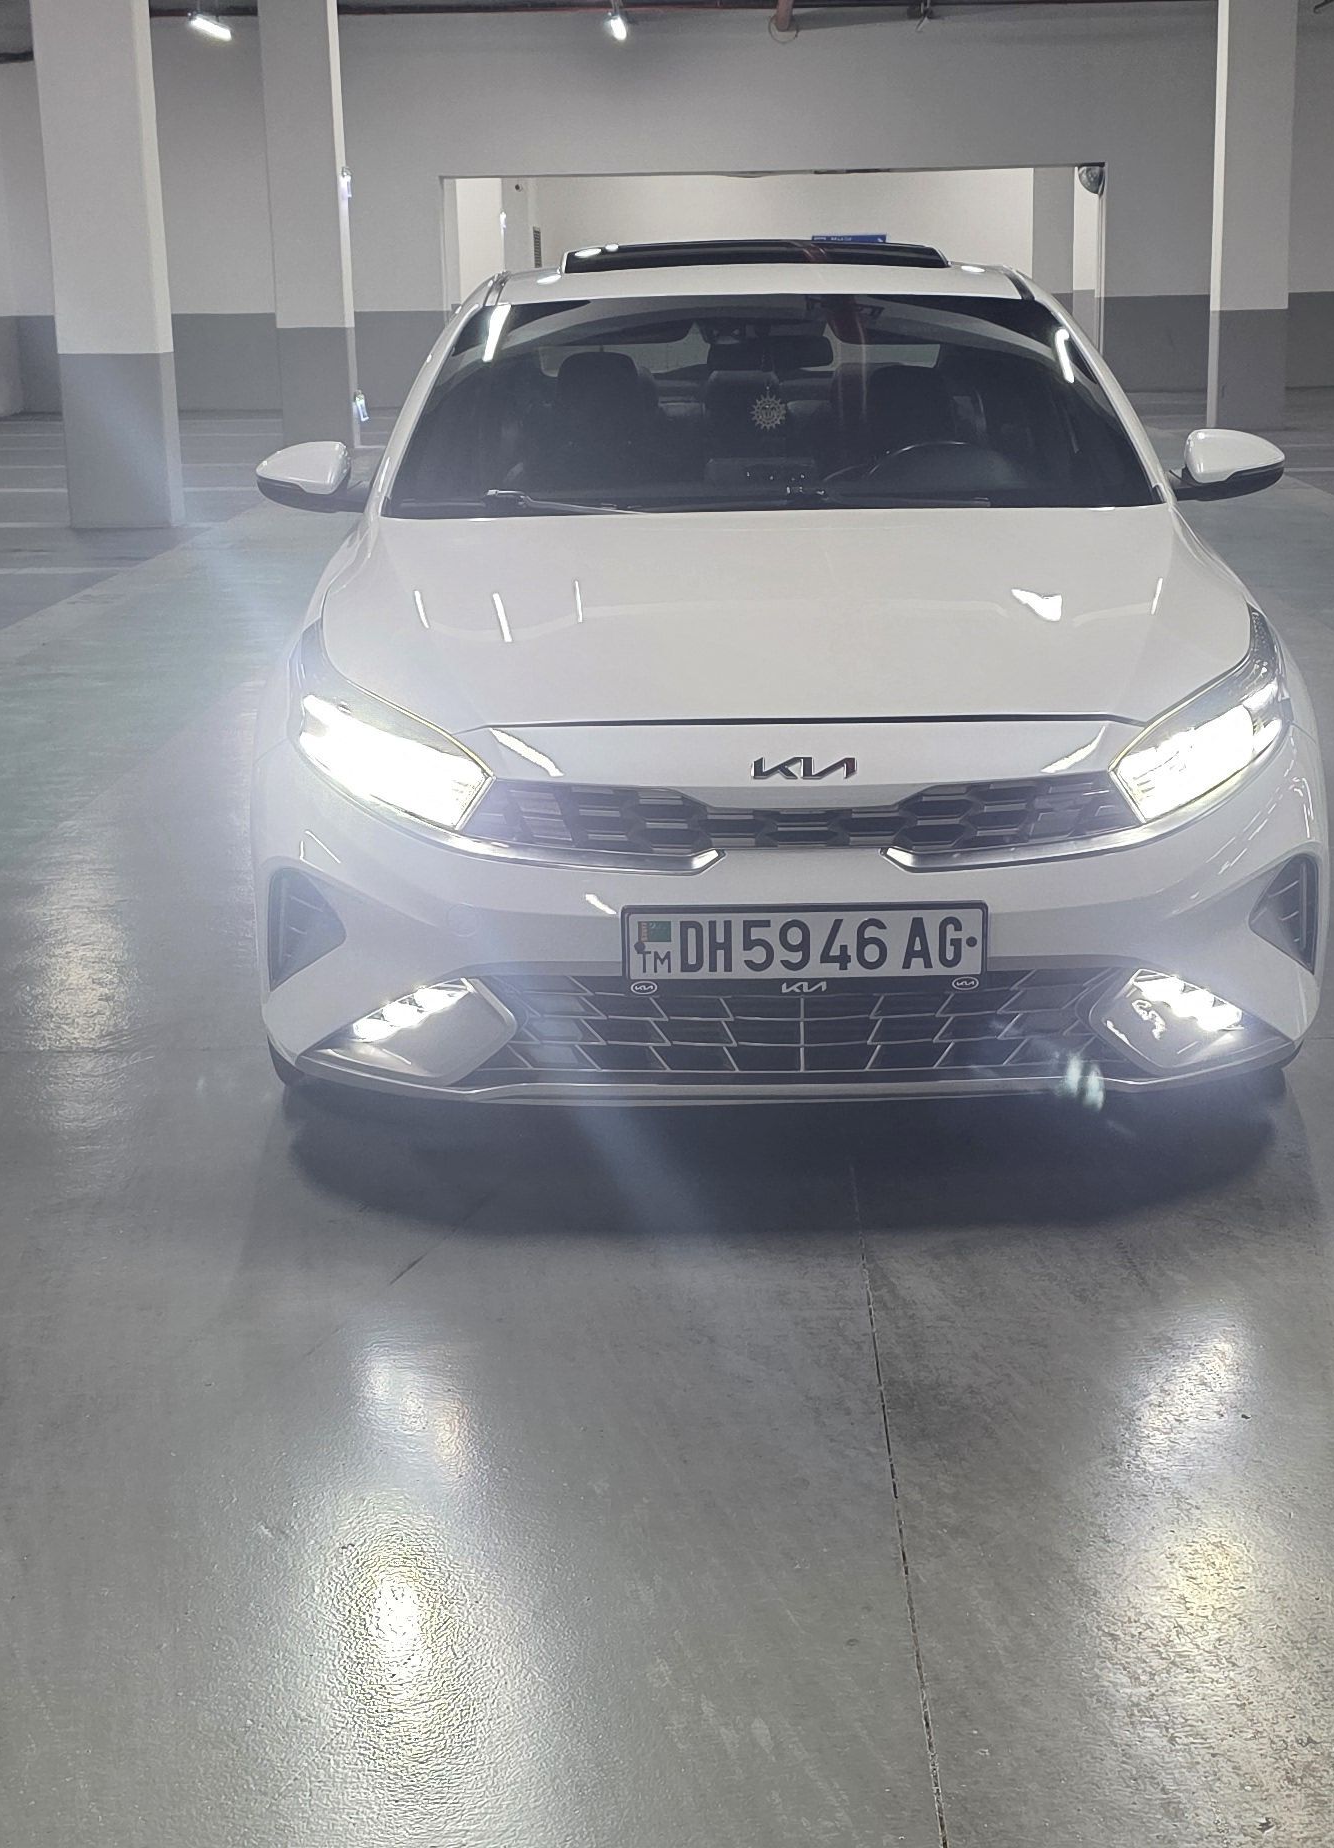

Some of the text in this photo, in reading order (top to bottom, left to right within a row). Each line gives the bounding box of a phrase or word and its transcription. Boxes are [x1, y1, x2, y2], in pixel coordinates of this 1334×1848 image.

[751, 756, 857, 780] KIA
[679, 916, 963, 973] DH 5946 AG
[636, 950, 672, 974] TM
[781, 980, 827, 993] KIA
